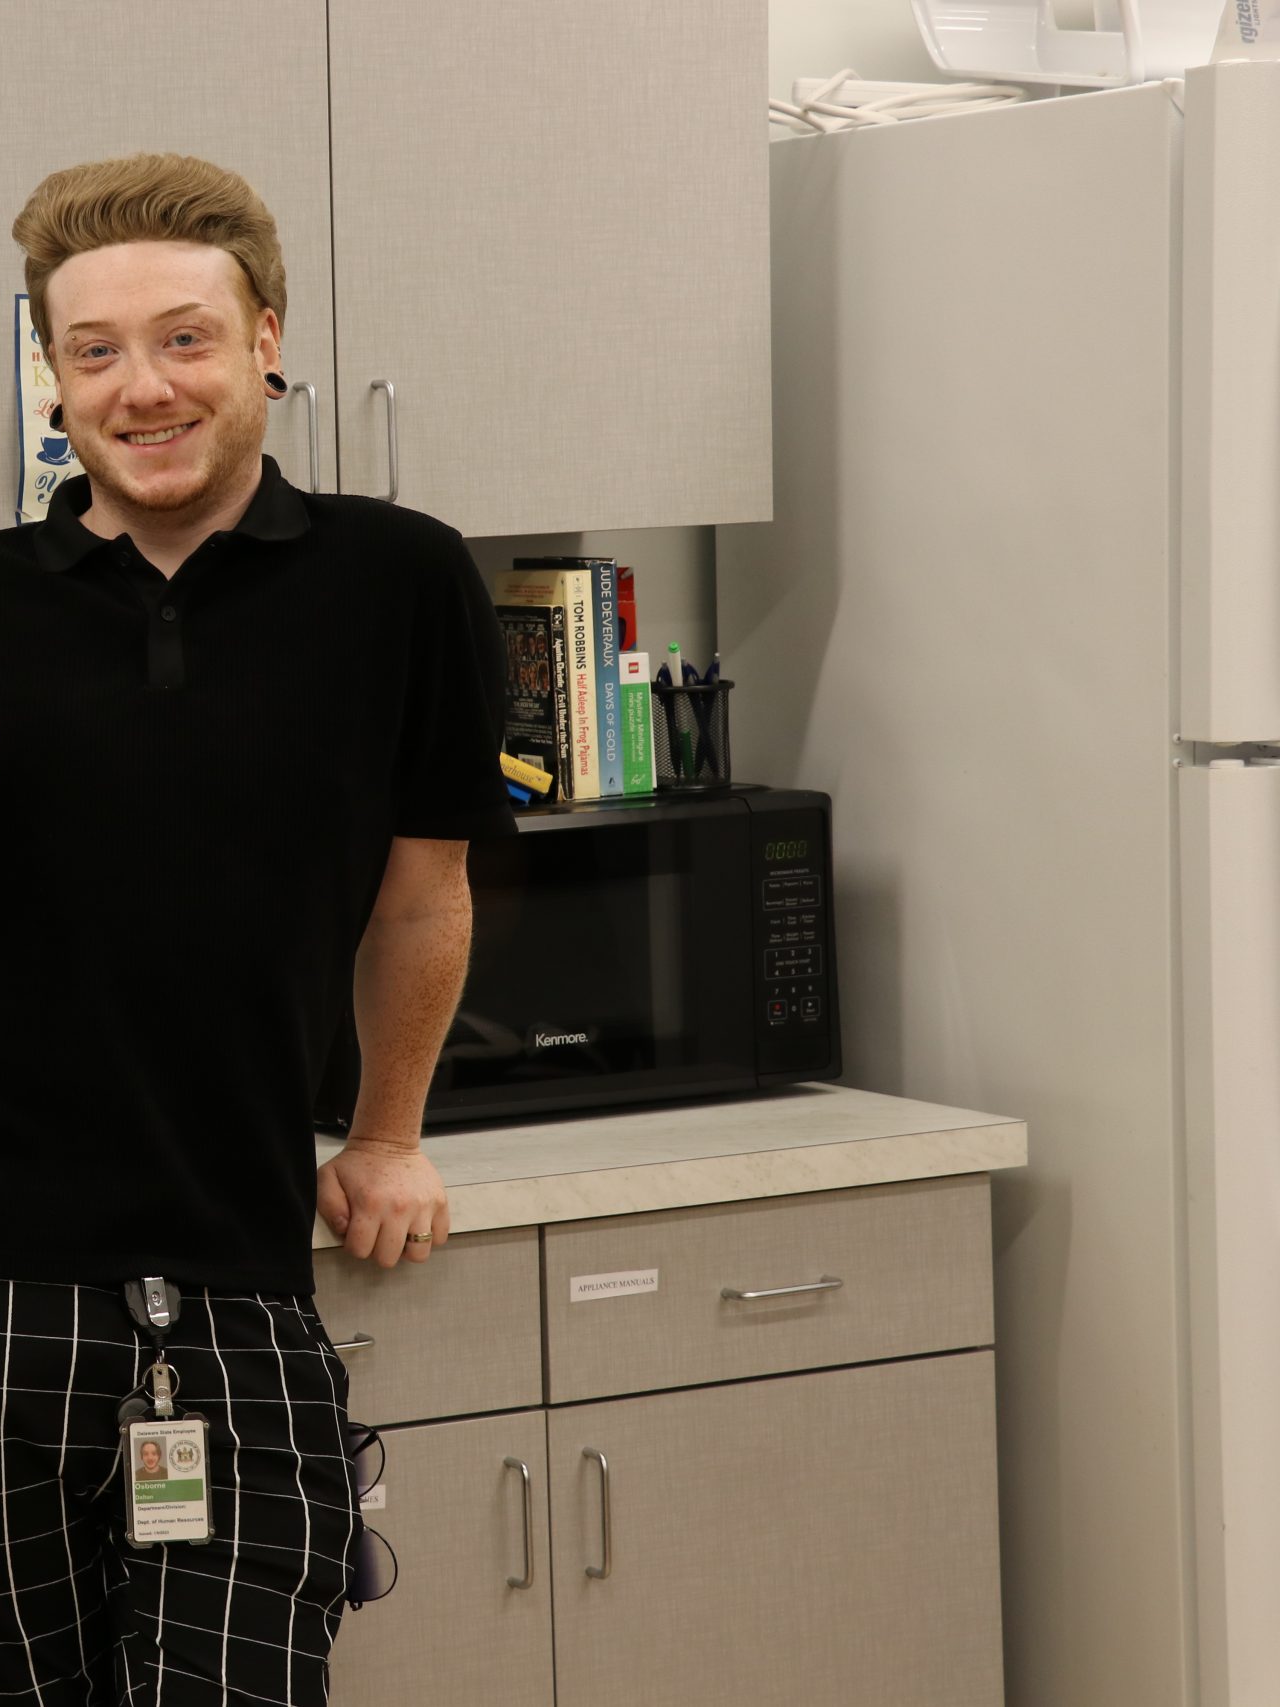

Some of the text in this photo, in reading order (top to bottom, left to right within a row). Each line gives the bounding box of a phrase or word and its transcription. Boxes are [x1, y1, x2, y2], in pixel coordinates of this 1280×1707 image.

[600, 567, 614, 667] JUDE DEVERAUX
[573, 600, 590, 776] TOM ROBBINS Half Asleep In Frog Pajamas
[604, 682, 616, 761] DAYS OF GOLD
[535, 1033, 586, 1047] Kenmore
[578, 1277, 655, 1292] APPLIANCE MANUALS
